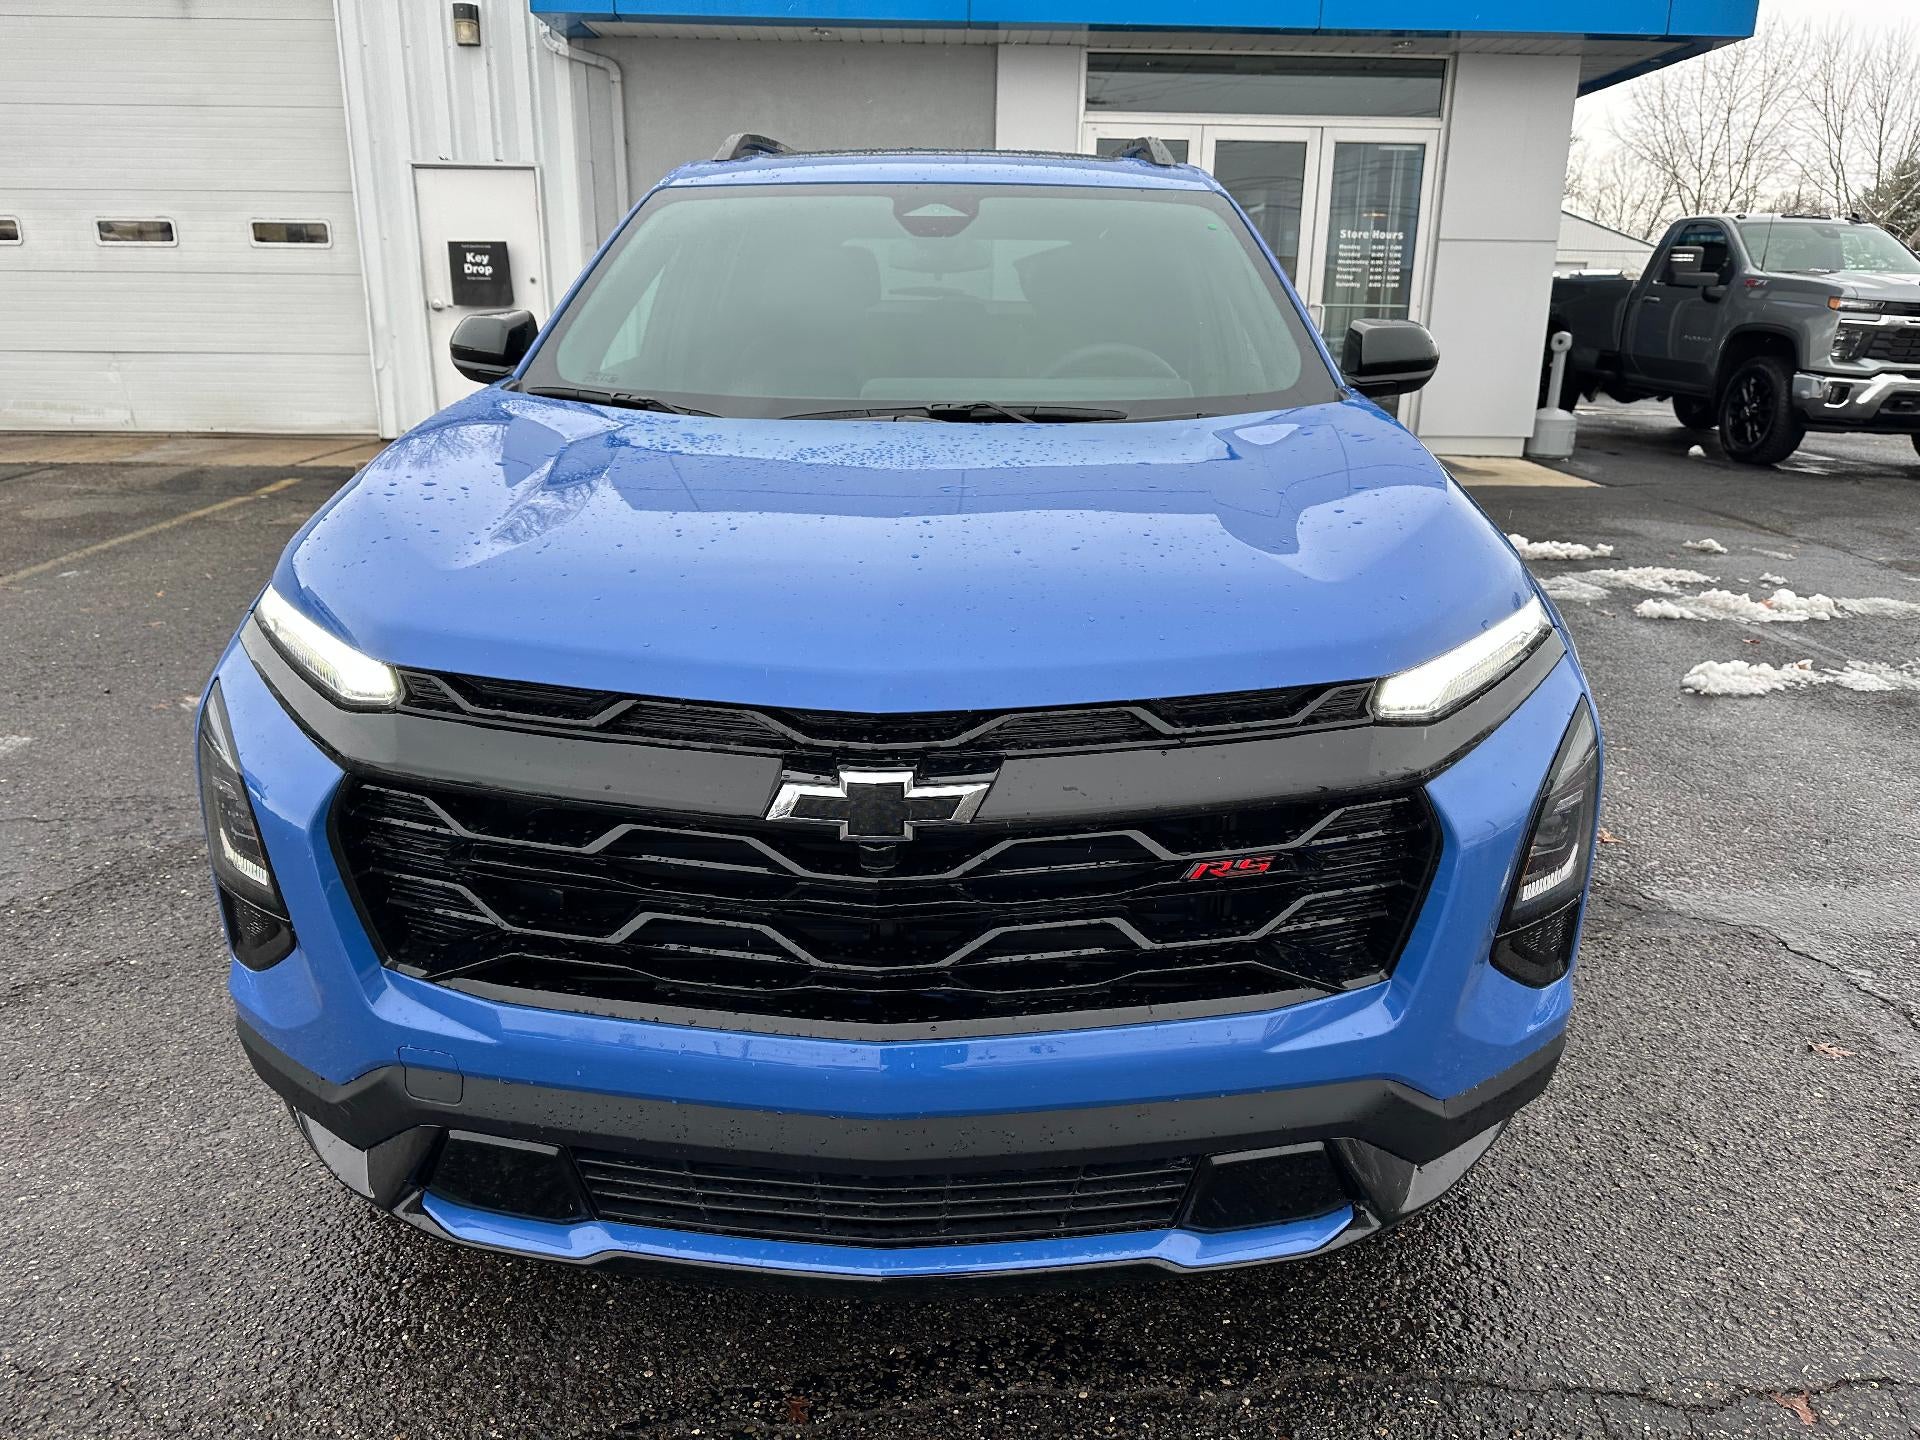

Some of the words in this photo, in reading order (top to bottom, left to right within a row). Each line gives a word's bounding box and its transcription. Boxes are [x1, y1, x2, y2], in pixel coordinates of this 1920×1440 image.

[1340, 229, 1369, 239] Store
[1372, 230, 1404, 240] Hours
[465, 252, 489, 265] Key
[463, 263, 493, 276] Drop
[1184, 857, 1276, 880] RS
